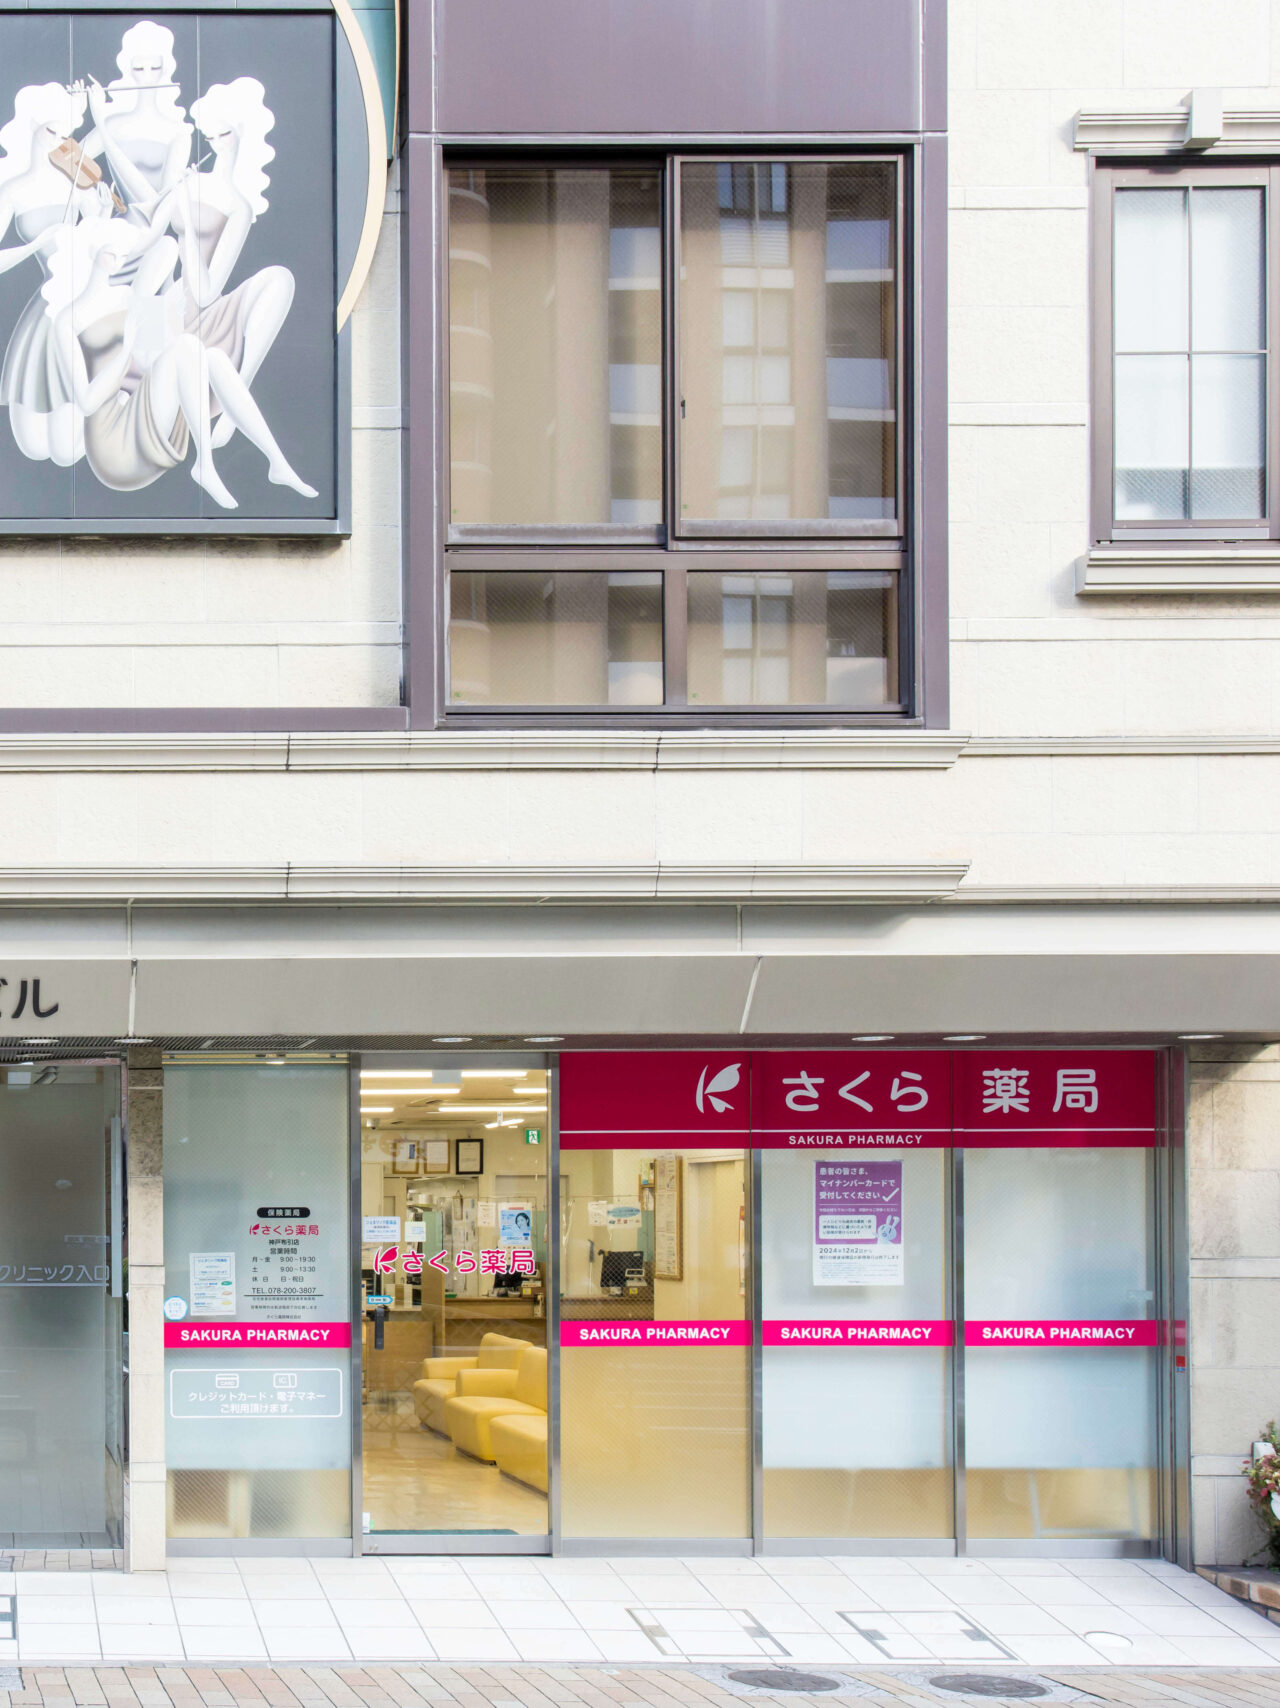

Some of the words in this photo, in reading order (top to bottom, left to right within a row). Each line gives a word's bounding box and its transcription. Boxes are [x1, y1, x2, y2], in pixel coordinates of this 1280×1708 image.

[789, 1135, 843, 1145] SAKURA
[848, 1135, 923, 1144] PHARMACY
[820, 1179, 896, 1187] マイナンバーカードで
[820, 1191, 880, 1199] 受付してください
[261, 1225, 319, 1236] さくら薬局
[270, 1247, 297, 1255] 営業時間
[401, 1249, 535, 1274] さくら薬局
[181, 1330, 242, 1341] SAKURA
[247, 1330, 330, 1341] PHARMACY
[579, 1328, 641, 1340] SAKURA
[646, 1327, 730, 1339] PHARMACY
[781, 1327, 843, 1339] SAKURA
[847, 1327, 932, 1339] PHARMACY
[982, 1327, 1045, 1339] SAKURA
[1050, 1327, 1135, 1339] PHARMACY
[188, 1391, 326, 1402] クレジットカード・電子マネー
